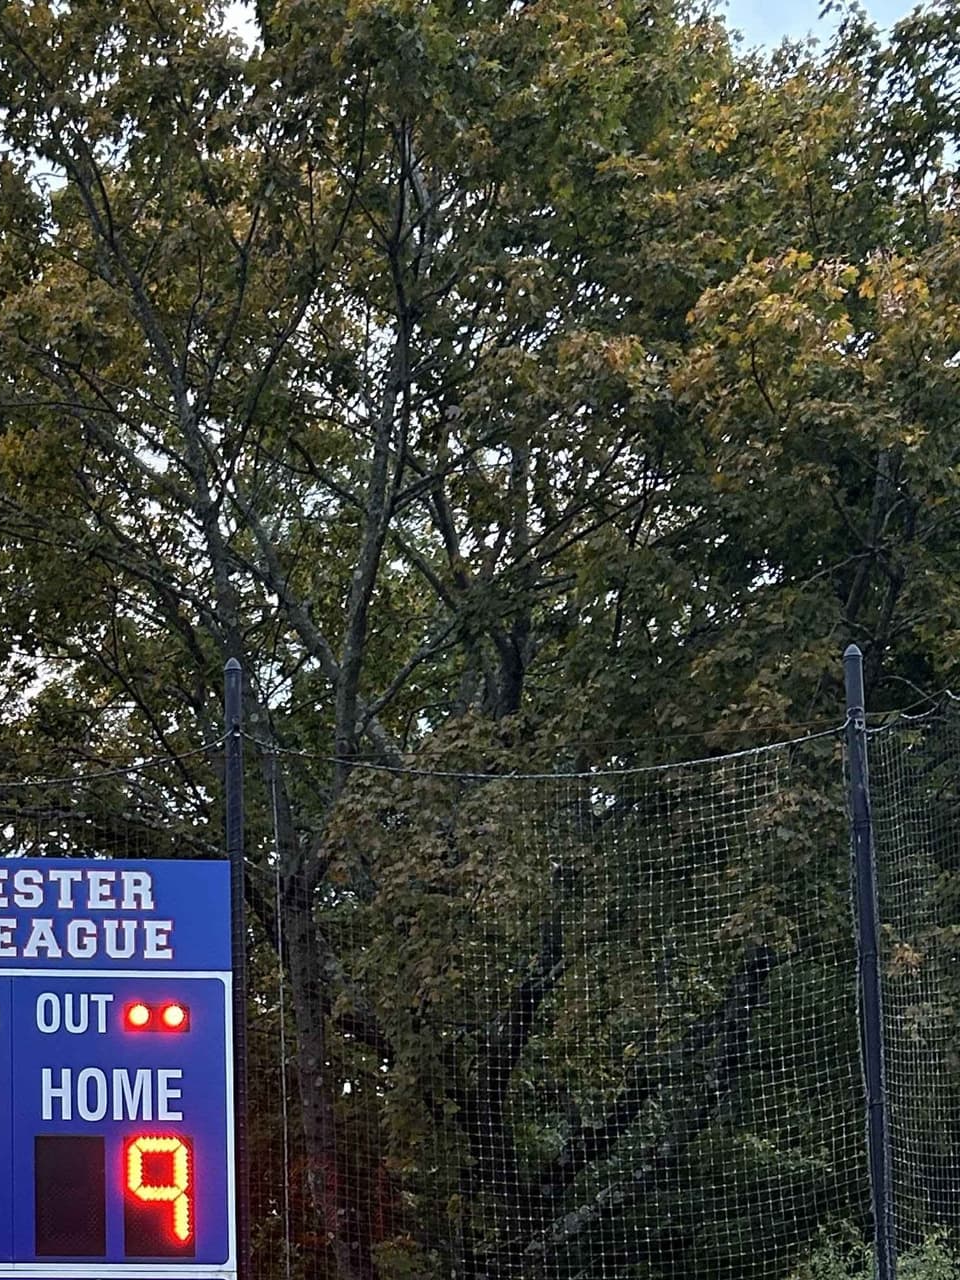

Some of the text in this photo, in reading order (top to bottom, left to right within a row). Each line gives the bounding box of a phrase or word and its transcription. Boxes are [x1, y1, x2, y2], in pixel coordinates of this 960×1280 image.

[36, 992, 113, 1033] OUT
[41, 1067, 183, 1121] HOME
[126, 1136, 189, 1241] 9
